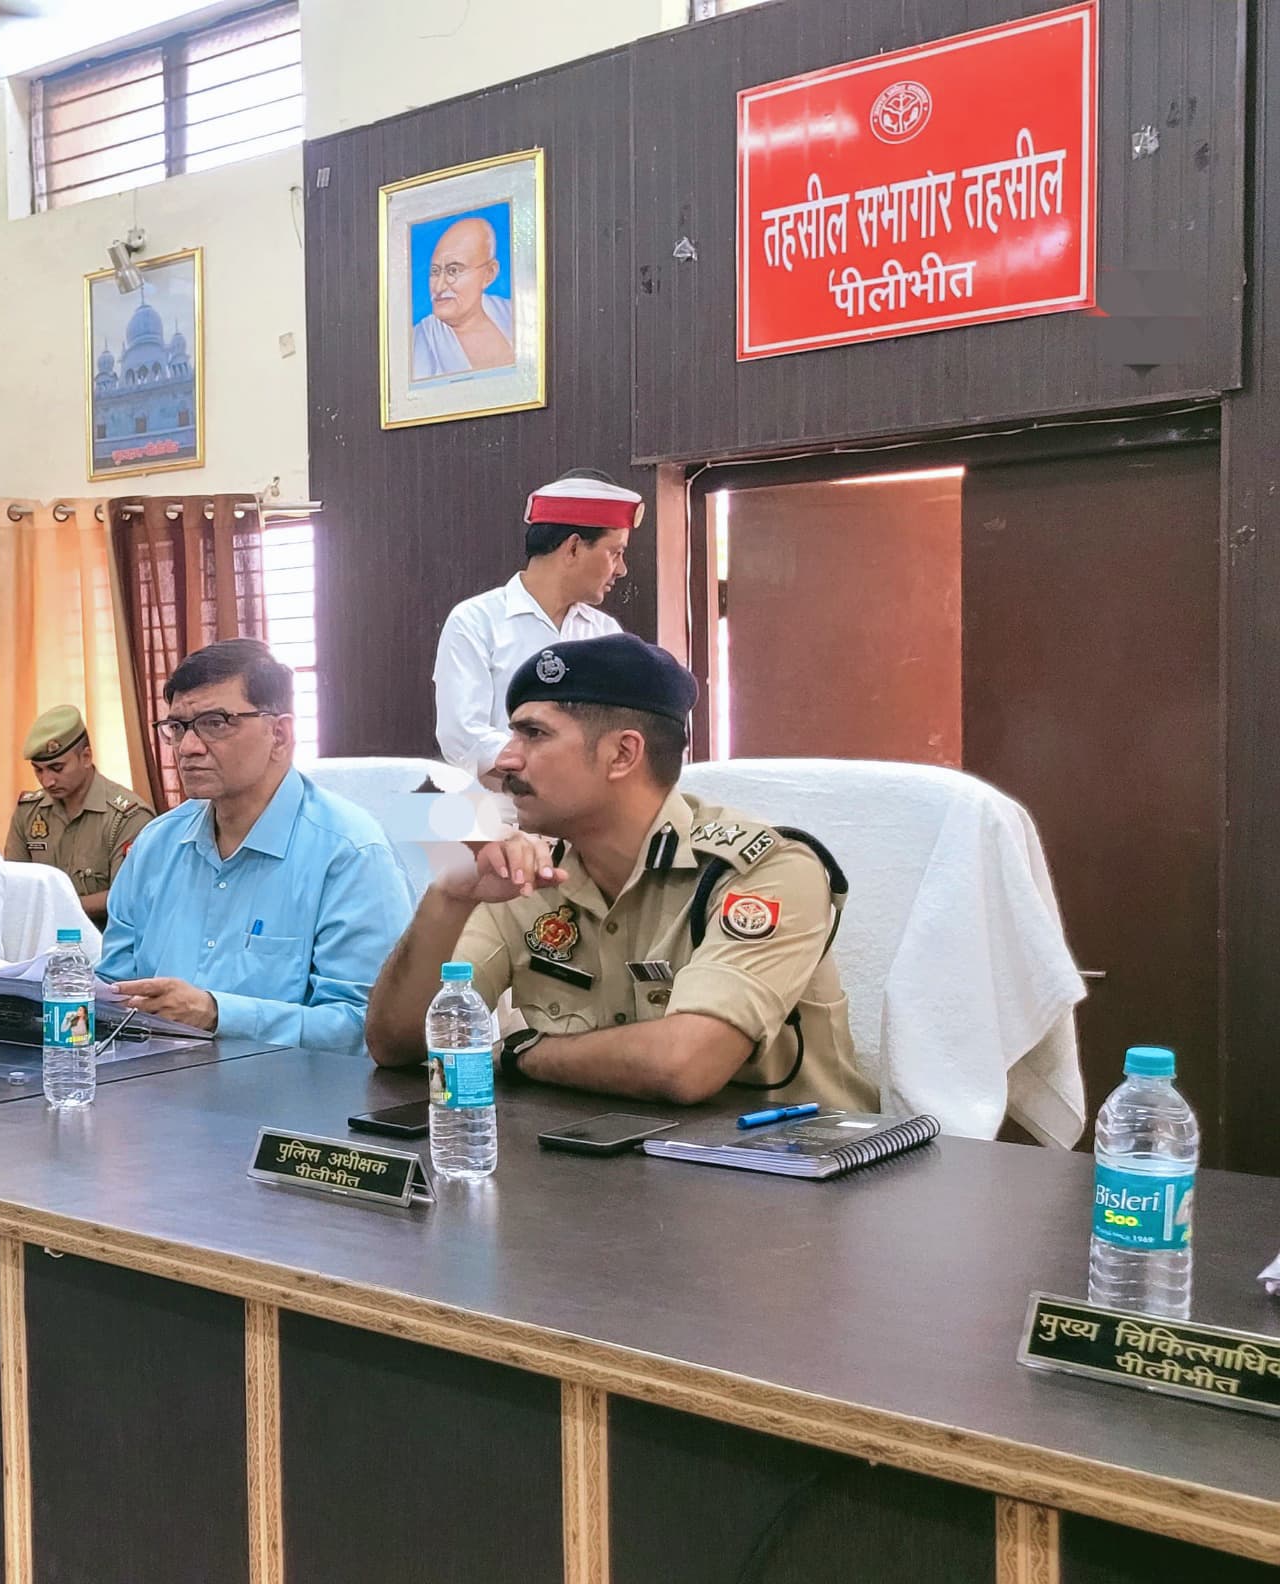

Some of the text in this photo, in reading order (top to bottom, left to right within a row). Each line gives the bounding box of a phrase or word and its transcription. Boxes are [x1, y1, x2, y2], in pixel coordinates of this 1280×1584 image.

[761, 173, 850, 271] तहसील
[962, 128, 1066, 233] तहसील
[829, 252, 977, 317] पीलीभीत
[742, 832, 774, 862] IPS
[276, 1140, 389, 1176] पुलिस अधीक्षक
[295, 1163, 360, 1188] पीलीभीत
[1095, 1184, 1161, 1211] Bisleri
[1039, 1312, 1101, 1342] मुख्य
[1114, 1352, 1241, 1394] पीलीभीत
